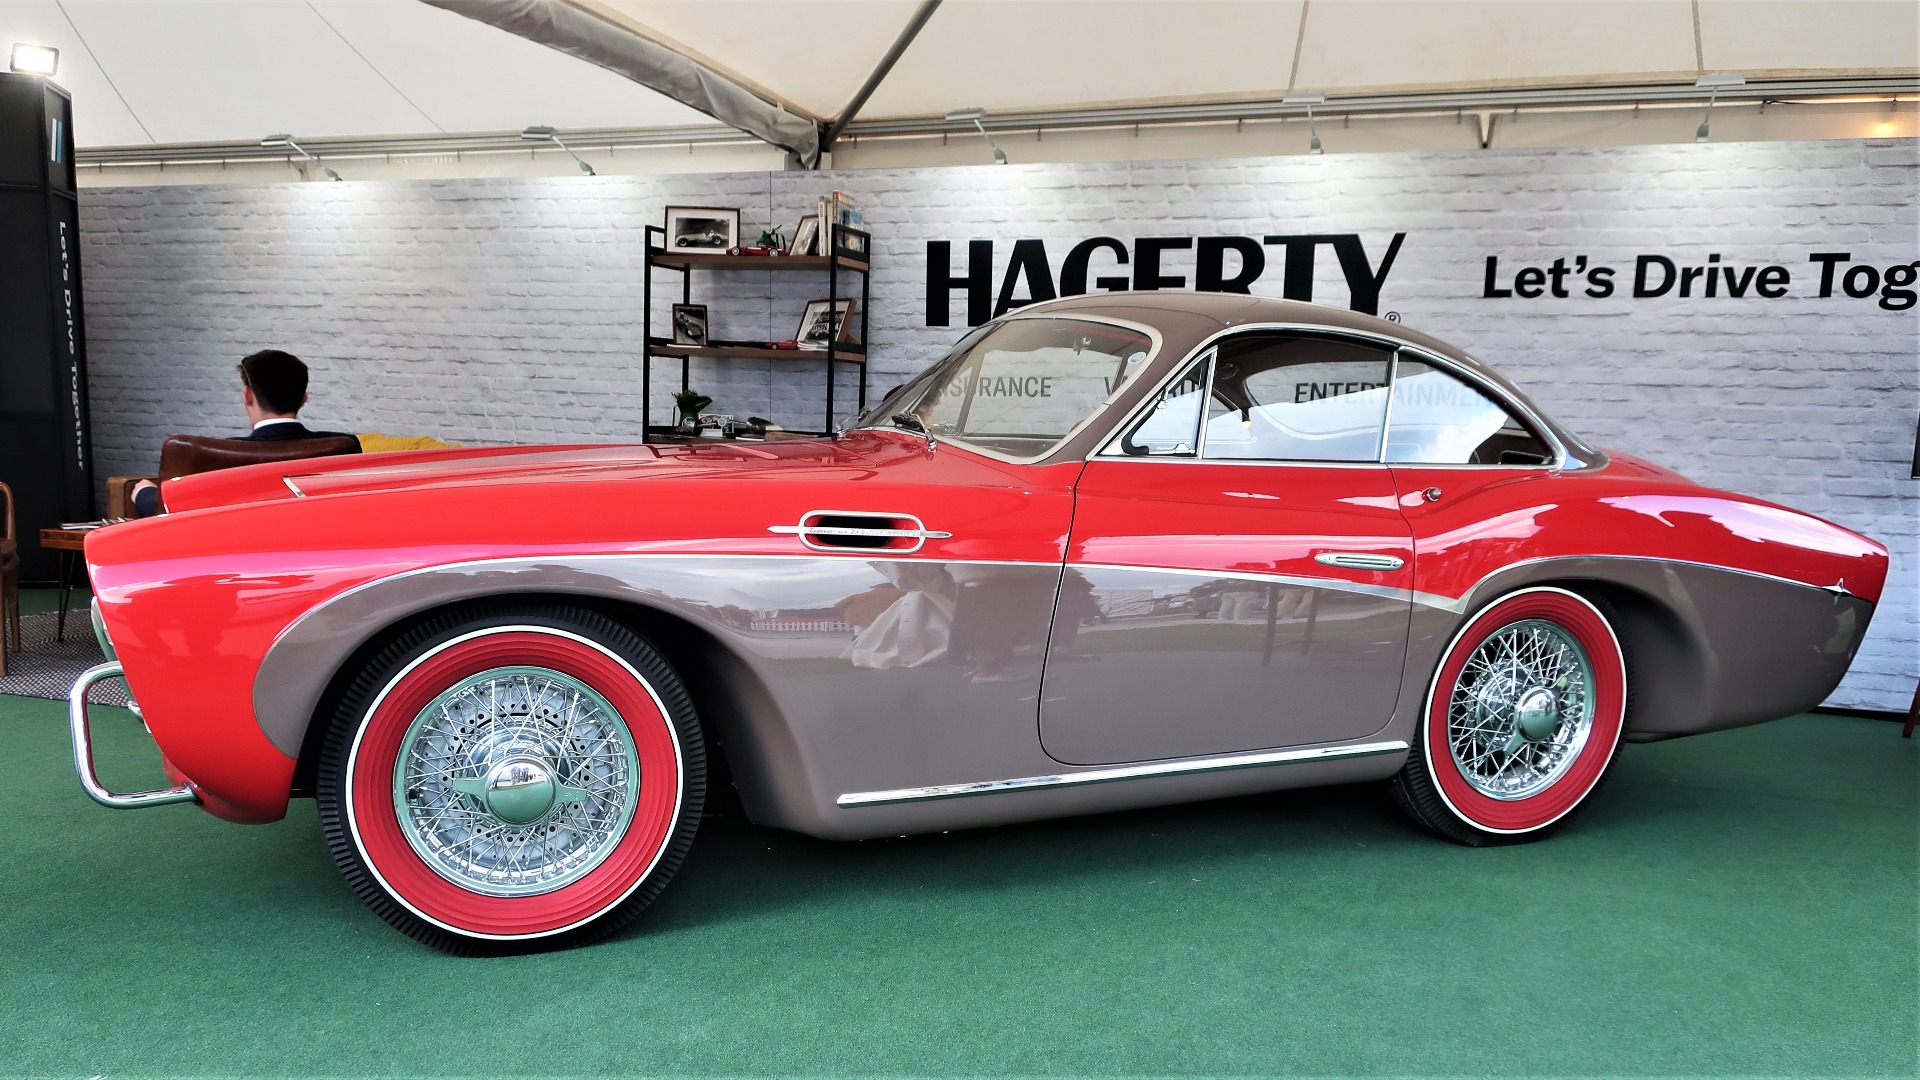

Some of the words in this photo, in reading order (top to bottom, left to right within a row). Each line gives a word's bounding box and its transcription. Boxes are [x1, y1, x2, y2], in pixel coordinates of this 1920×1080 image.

[926, 233, 1406, 328] HAGERTY
[1483, 256, 1615, 299] Let's
[1633, 254, 1790, 299] Drive
[1809, 253, 1920, 311] Tog
[59, 221, 68, 281] Let's
[64, 288, 75, 355] Drive
[71, 361, 84, 470] Together
